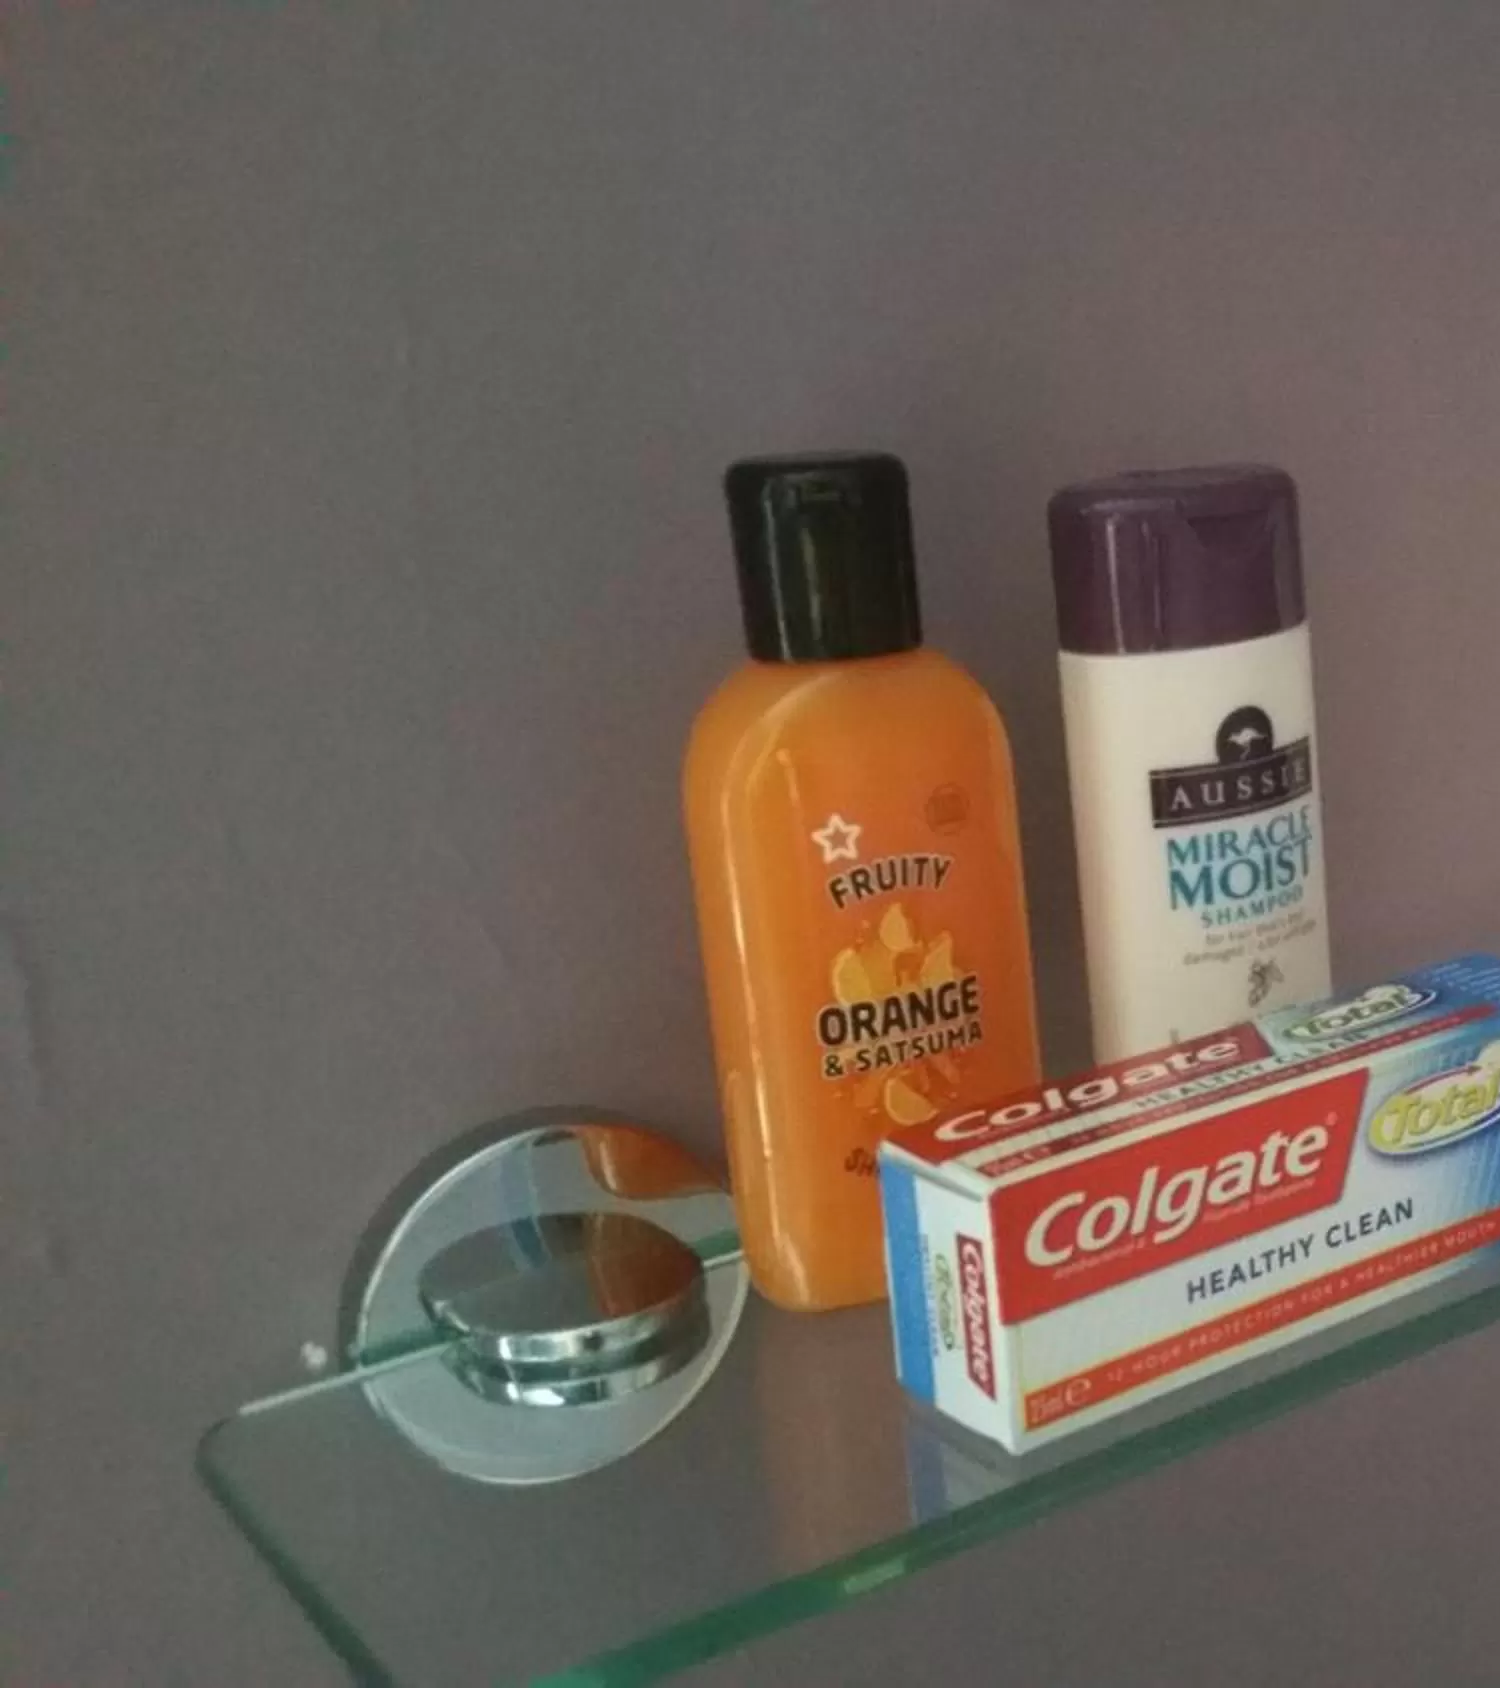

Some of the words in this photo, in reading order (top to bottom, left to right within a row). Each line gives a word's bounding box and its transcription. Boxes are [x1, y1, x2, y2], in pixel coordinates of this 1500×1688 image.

[1170, 763, 1306, 811] AUSSIE
[1166, 804, 1312, 867] MIRACLE
[829, 857, 952, 910] FRUITY
[1169, 838, 1311, 911] MOIST
[817, 975, 981, 1047] ORANGE
[824, 1054, 845, 1077] &
[855, 1019, 983, 1073] SATSUMA
[933, 1039, 1240, 1143] Colgate
[1023, 1123, 1329, 1269] Colgate
[1186, 1233, 1315, 1305] HEALTHY
[1325, 1197, 1415, 1249] CLEAN
[961, 1240, 991, 1384] Colgate
[1188, 1299, 1295, 1351] PROTECTION
[1299, 1281, 1334, 1304] FOR
[1339, 1274, 1351, 1292] A
[1353, 1239, 1440, 1284] HEALTHIER
